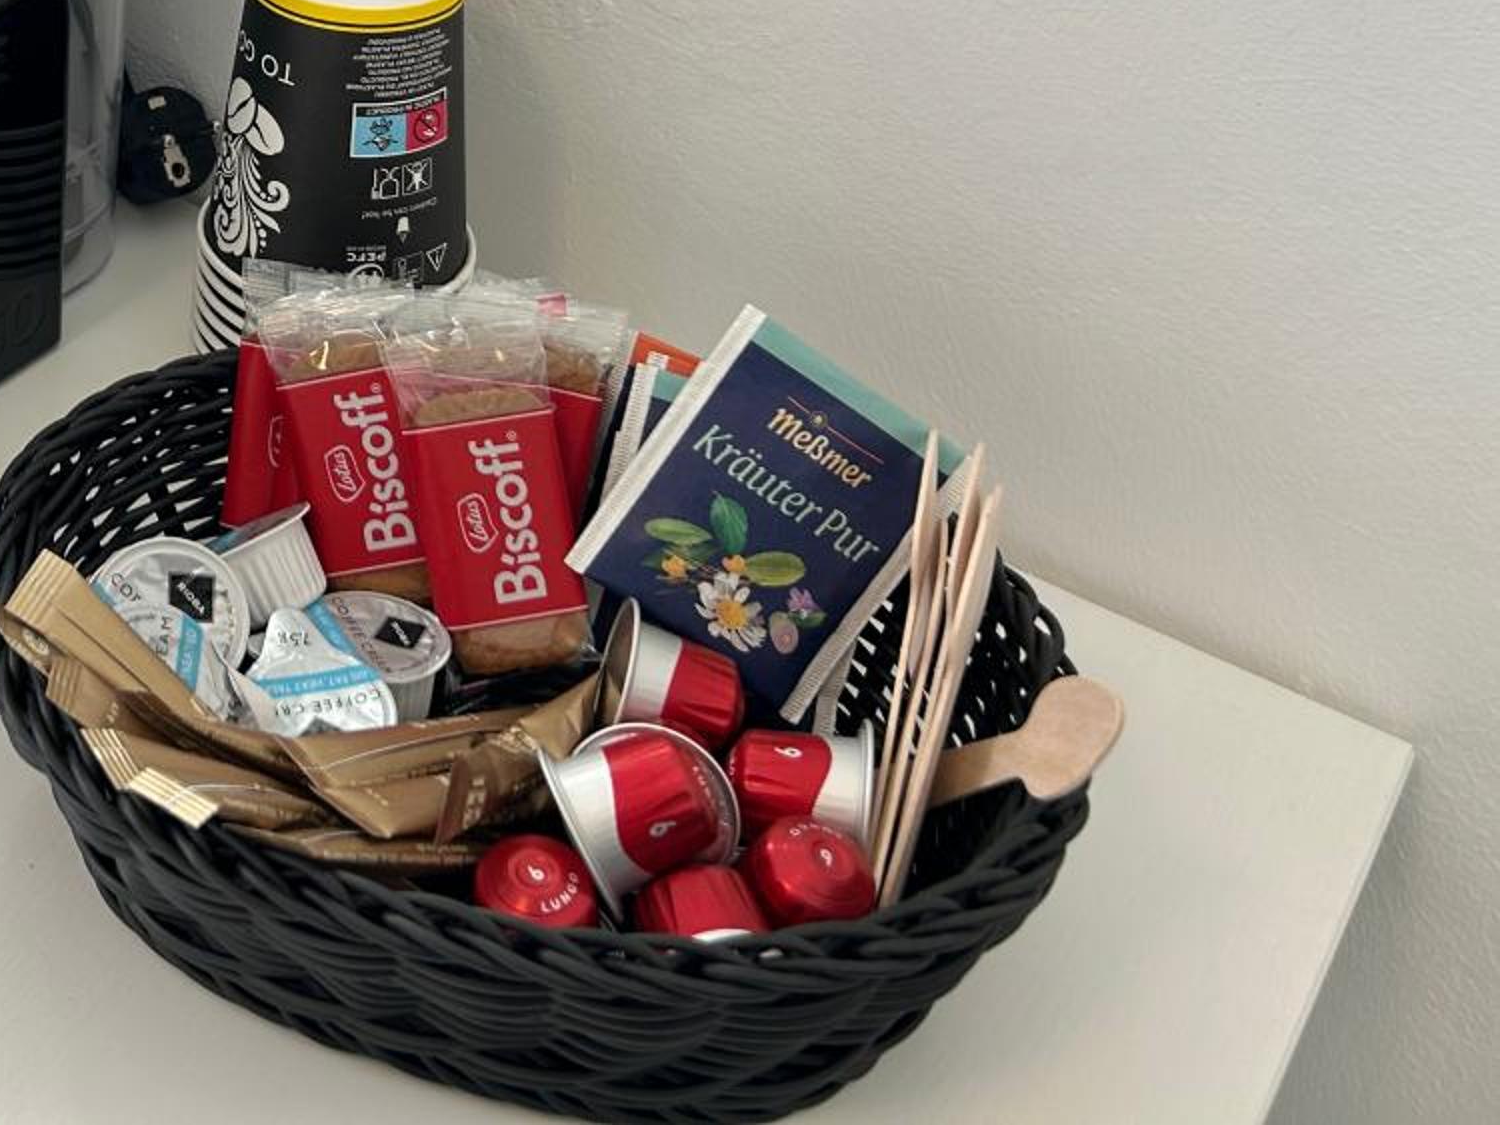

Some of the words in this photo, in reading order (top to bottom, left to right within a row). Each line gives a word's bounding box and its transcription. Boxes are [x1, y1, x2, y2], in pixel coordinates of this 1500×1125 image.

[262, 54, 296, 87] TO
[346, 251, 387, 263] PEFC
[332, 389, 418, 553] Biscoff
[692, 424, 823, 525] Kräuter
[813, 507, 880, 564] Pur
[468, 439, 548, 604] Biscoff
[310, 686, 382, 714] COFFEE
[541, 872, 579, 915] LUNGO
